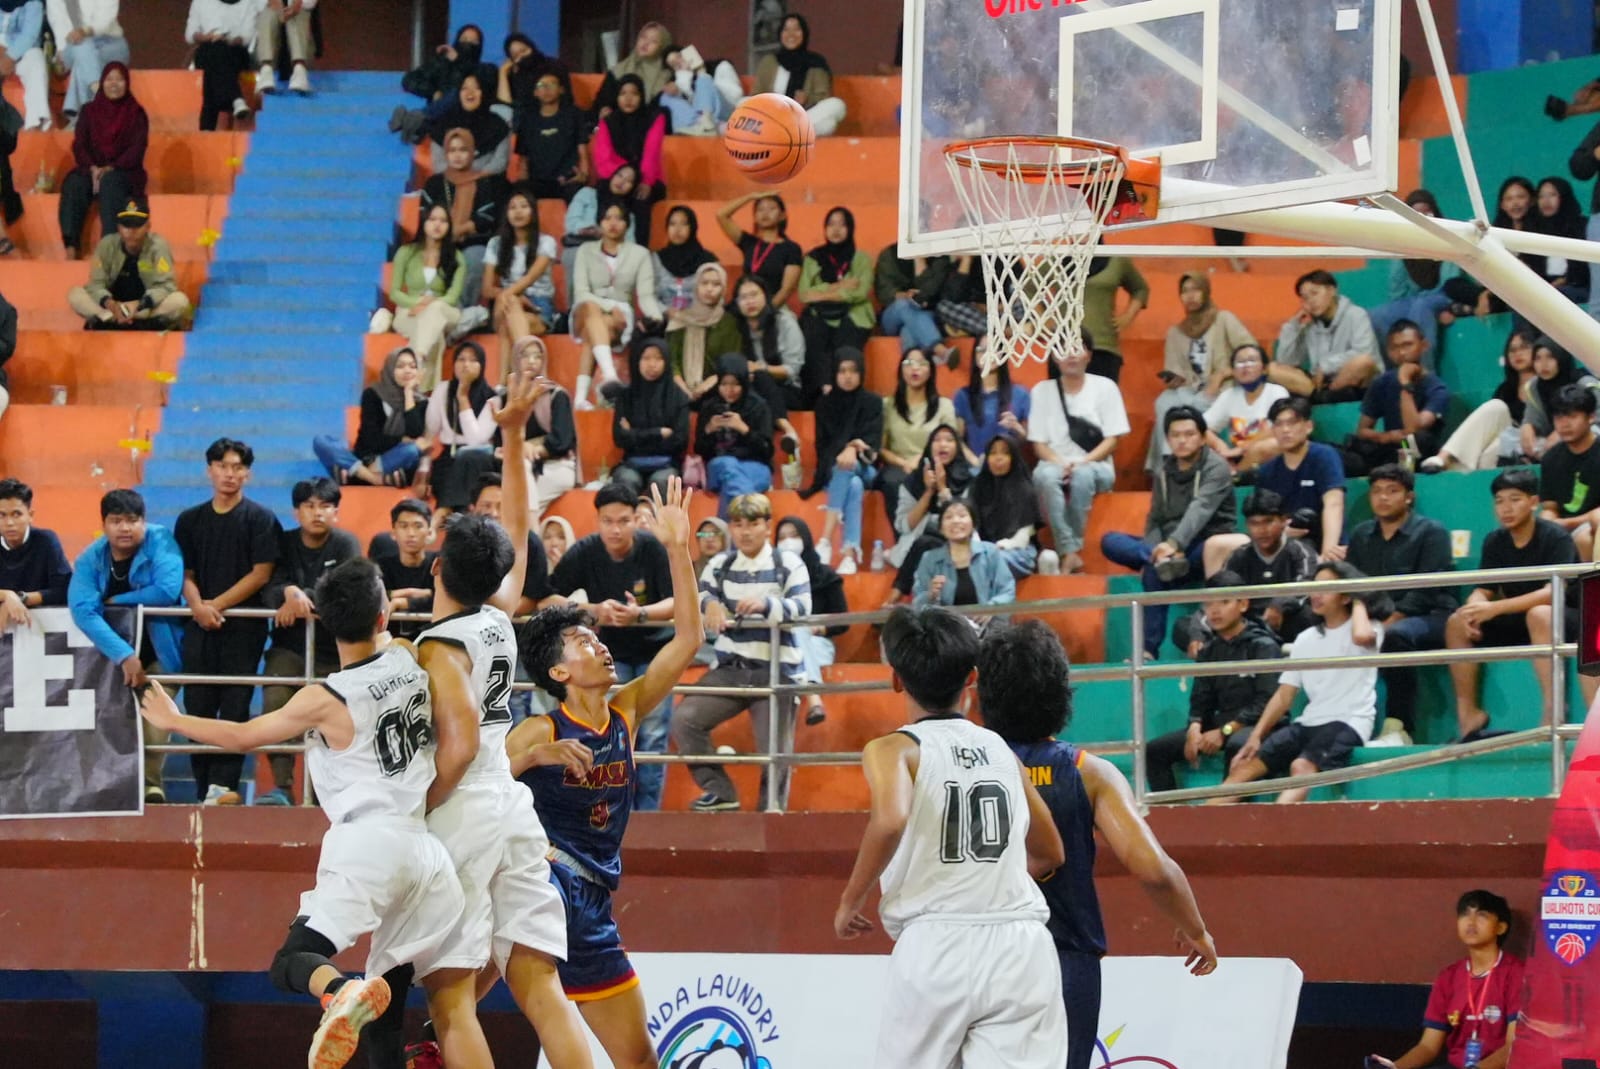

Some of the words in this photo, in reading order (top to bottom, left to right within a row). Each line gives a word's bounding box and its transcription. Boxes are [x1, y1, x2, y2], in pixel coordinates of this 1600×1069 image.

[3, 606, 96, 732] E
[480, 655, 513, 727] 2
[373, 688, 432, 777] 06
[940, 780, 1013, 864] 10
[1544, 902, 1585, 915] WALIKOTA
[647, 986, 690, 1039] NDA
[697, 973, 780, 1043] LAUNDRY
